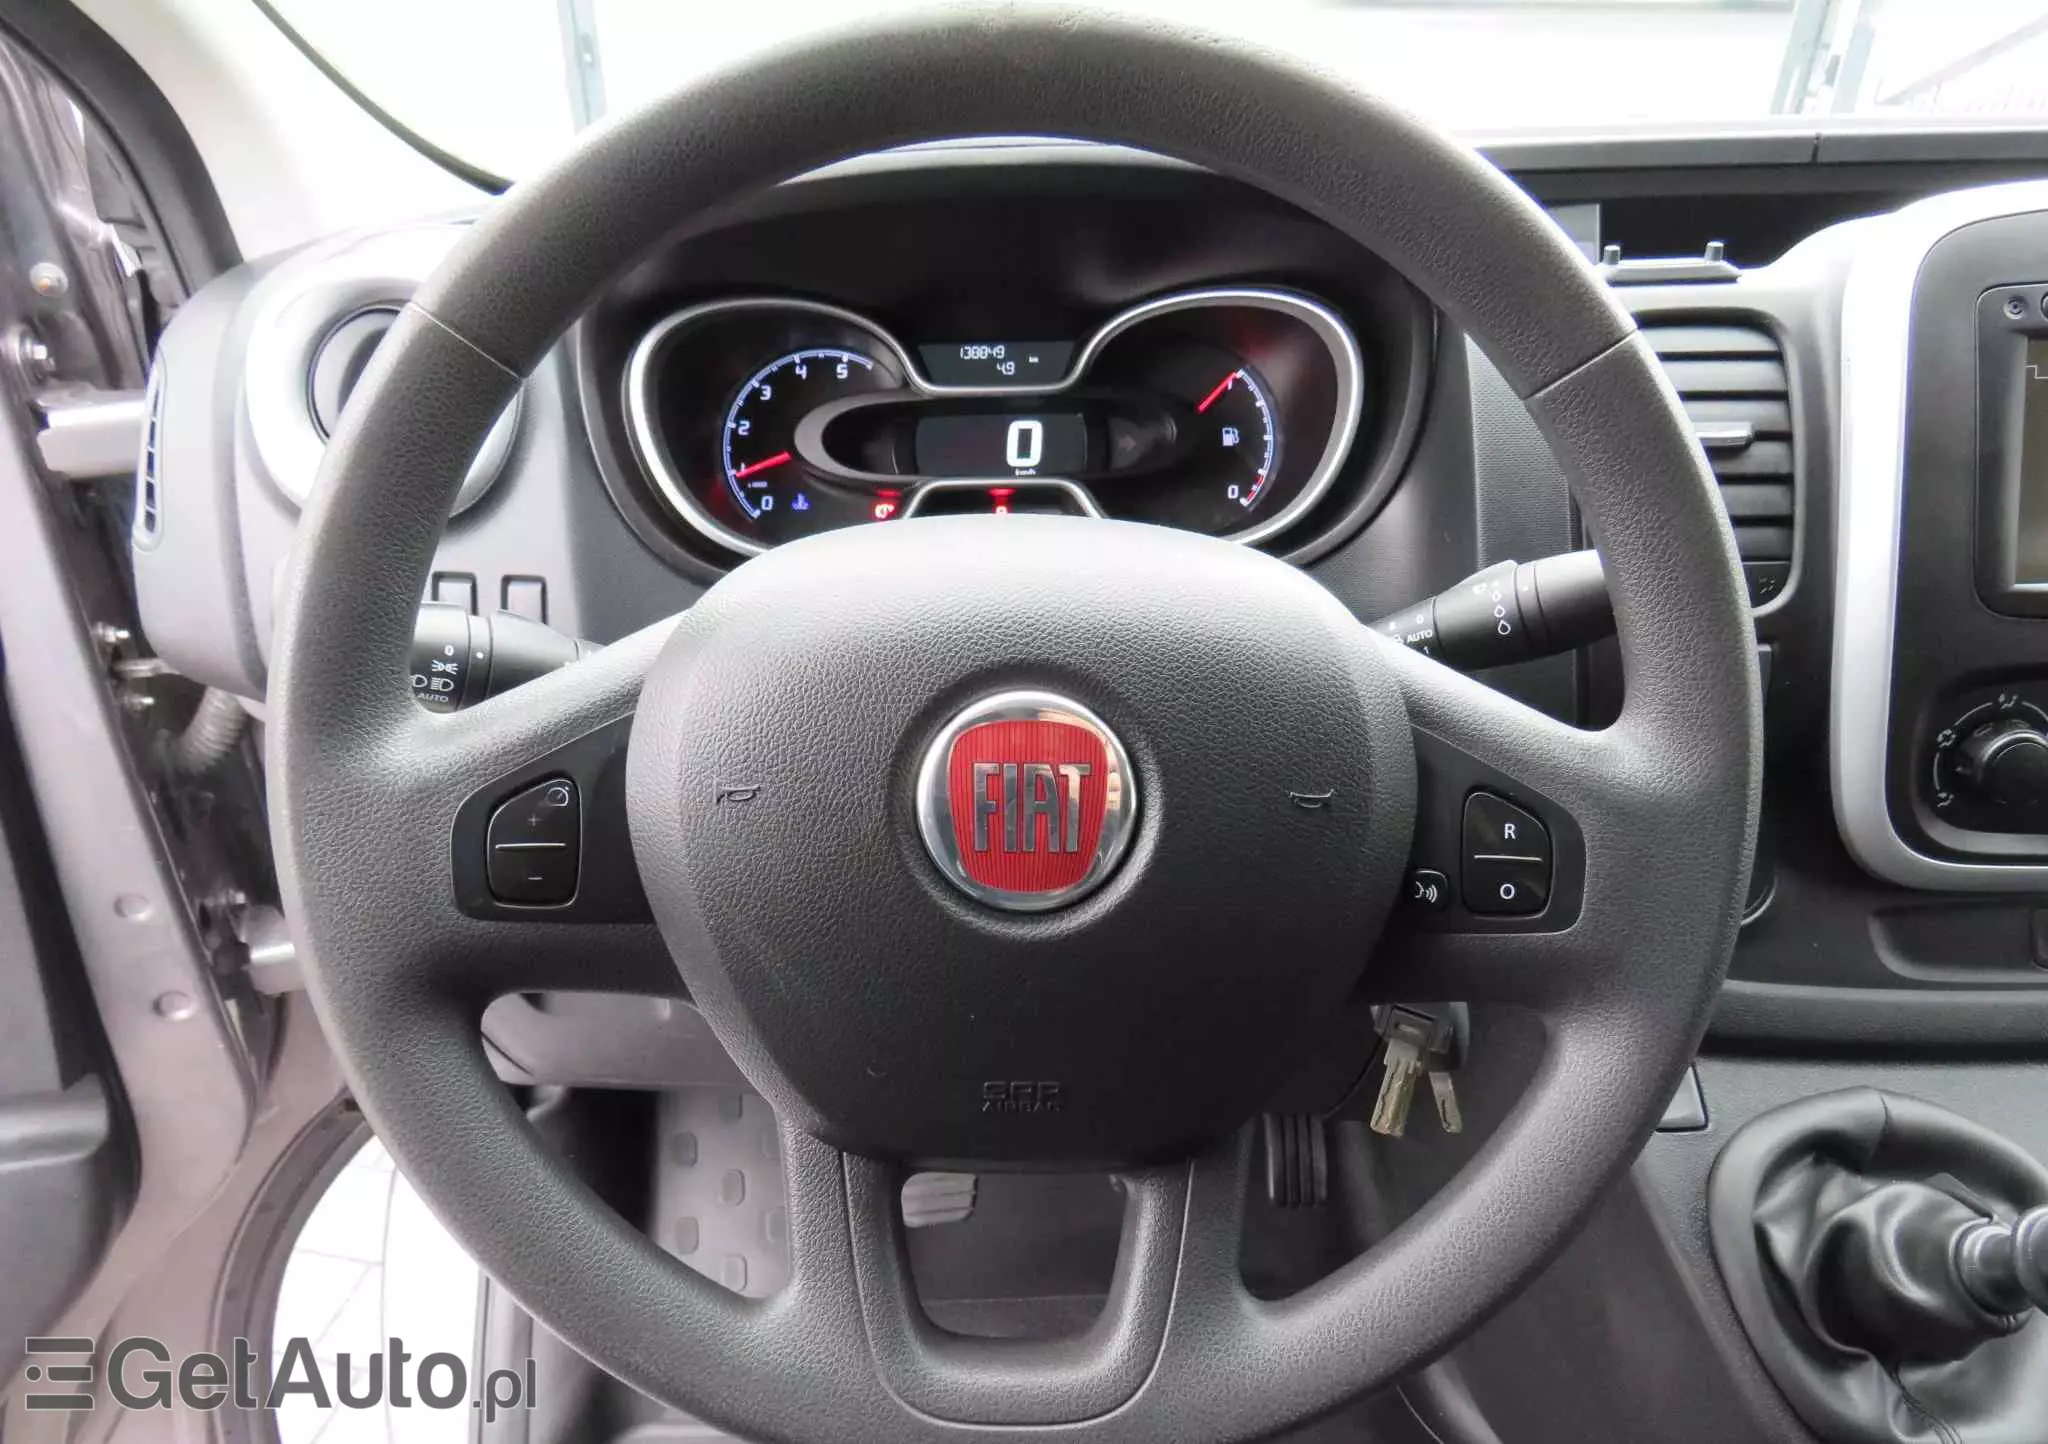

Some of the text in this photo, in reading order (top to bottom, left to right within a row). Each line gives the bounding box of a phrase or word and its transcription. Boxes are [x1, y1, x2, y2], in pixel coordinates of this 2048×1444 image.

[795, 365, 808, 380] 4
[836, 364, 849, 379] 5
[760, 385, 772, 400] 3
[738, 420, 750, 435] 2
[1006, 420, 1044, 467] 0
[1227, 484, 1239, 499] 0
[761, 495, 774, 511] 0
[1406, 627, 1433, 644] AUTO
[418, 691, 449, 703] AUTO
[973, 762, 1092, 853] FIAT
[1504, 823, 1516, 839] R
